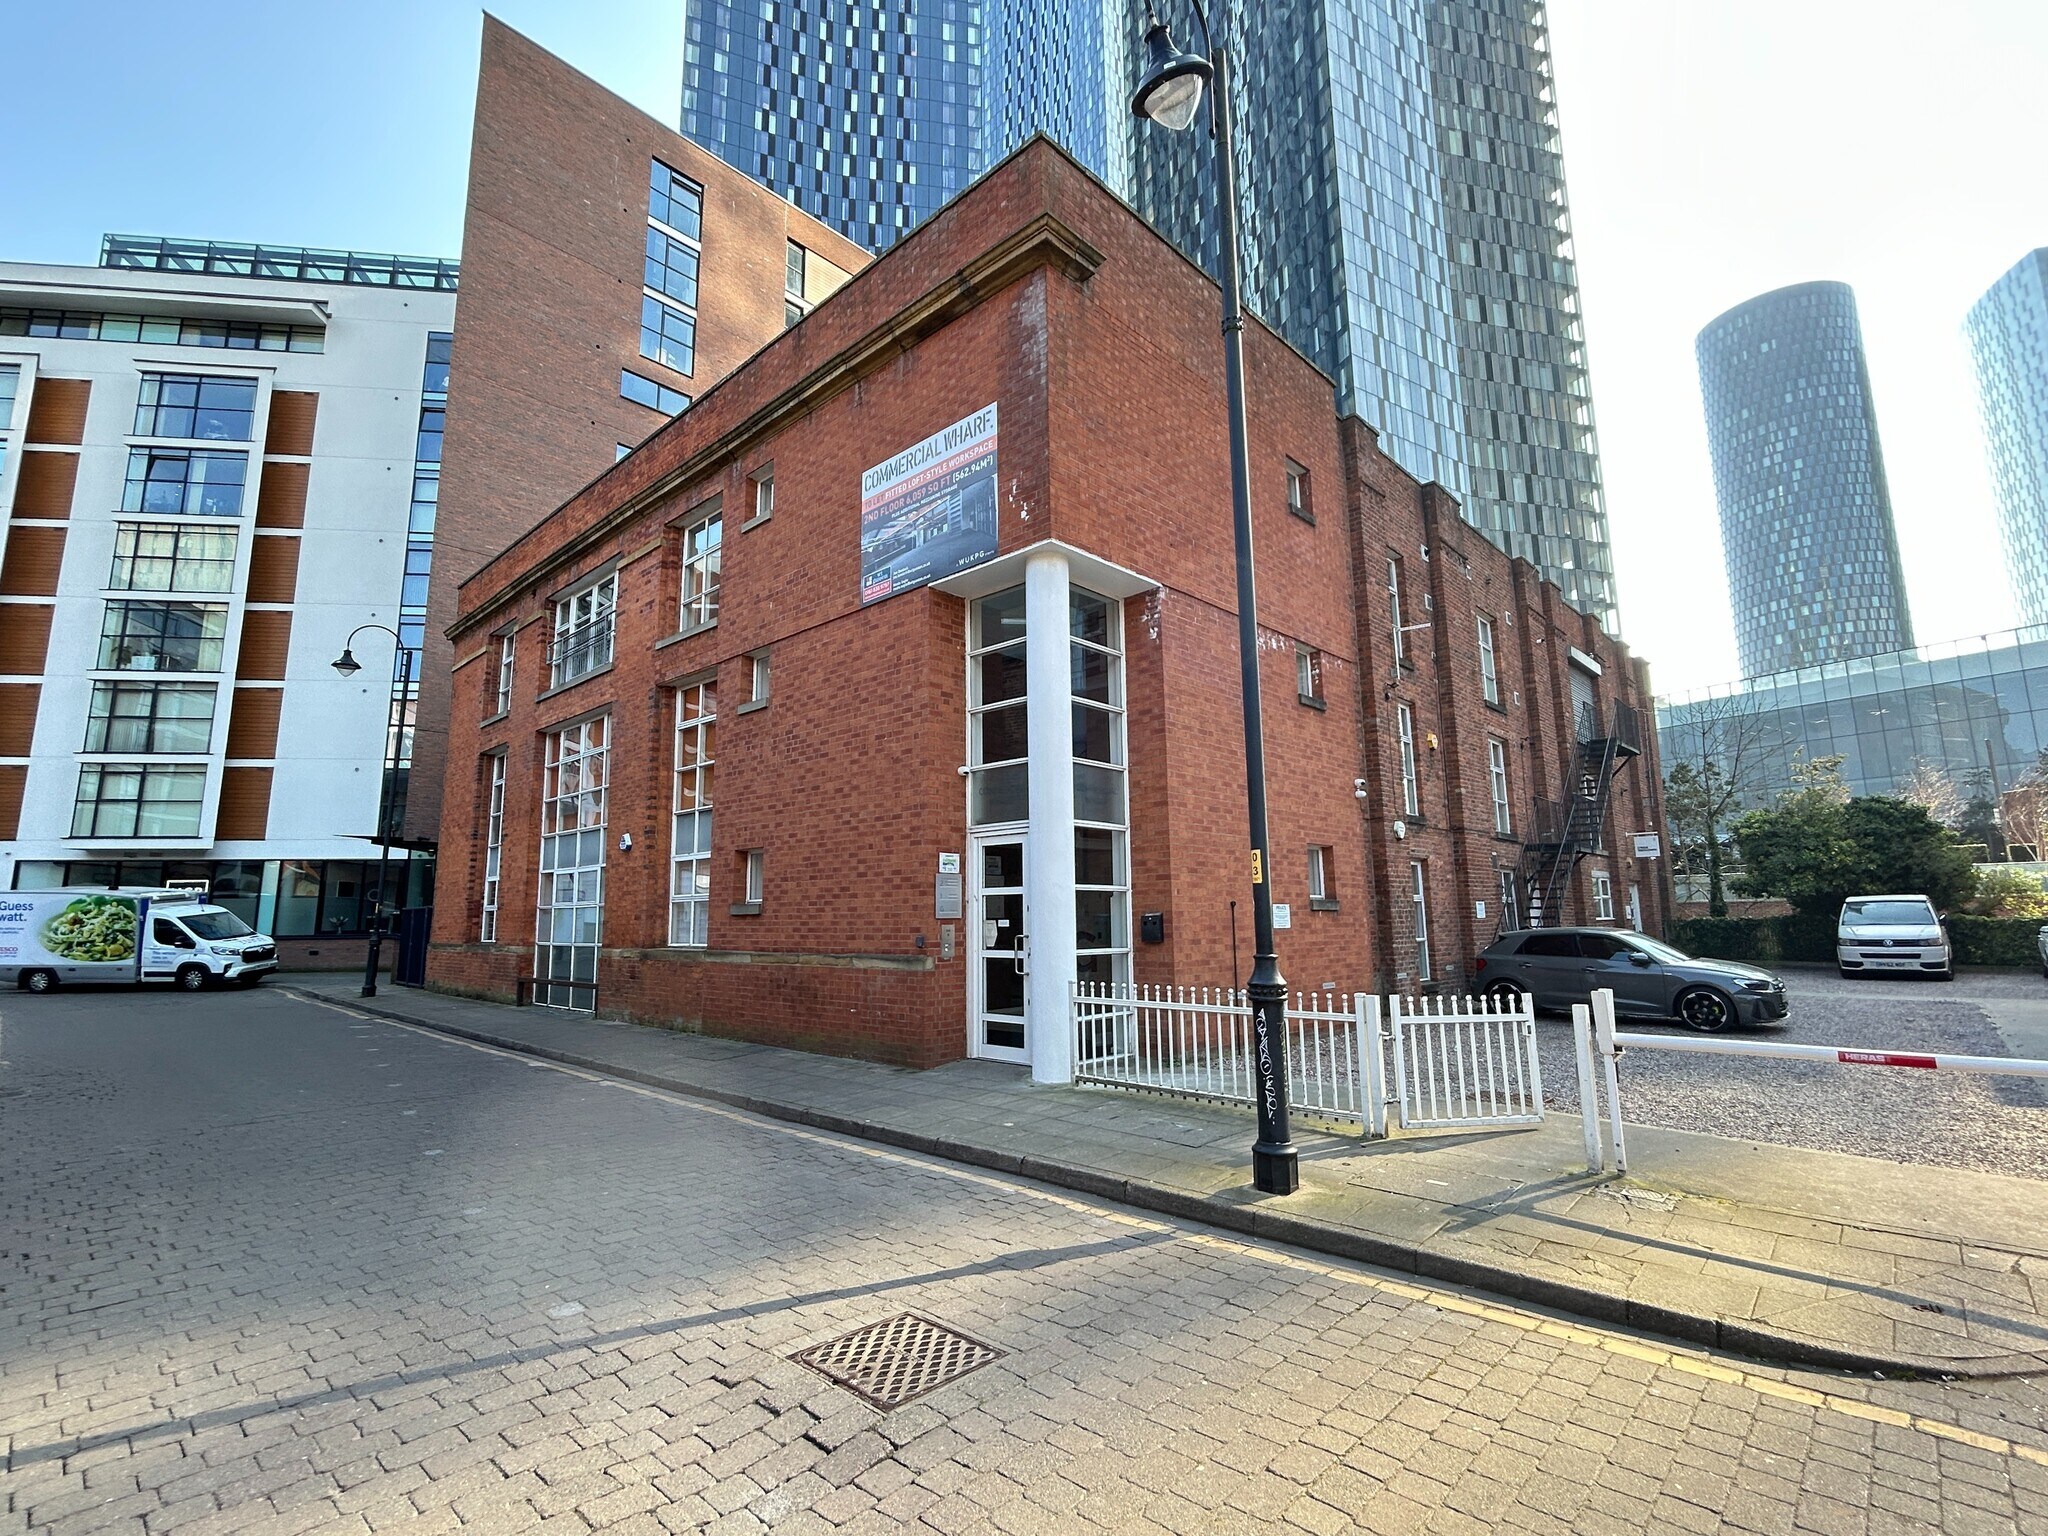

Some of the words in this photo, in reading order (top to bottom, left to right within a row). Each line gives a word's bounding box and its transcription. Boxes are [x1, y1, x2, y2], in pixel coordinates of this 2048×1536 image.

[864, 439, 942, 492] COMMERCIAL
[943, 409, 994, 452] WHARF.
[885, 483, 907, 499] FITTED
[908, 463, 948, 491] LOFT-STYLE
[948, 441, 993, 468] WORKSPACE
[864, 510, 878, 524] 2ND
[880, 498, 904, 516] FLOOR
[905, 488, 926, 504] 6,059
[928, 482, 939, 493] SQ
[940, 475, 950, 488] FT
[0, 901, 34, 911] Guess
[1844, 1052, 1885, 1062] HERAS
